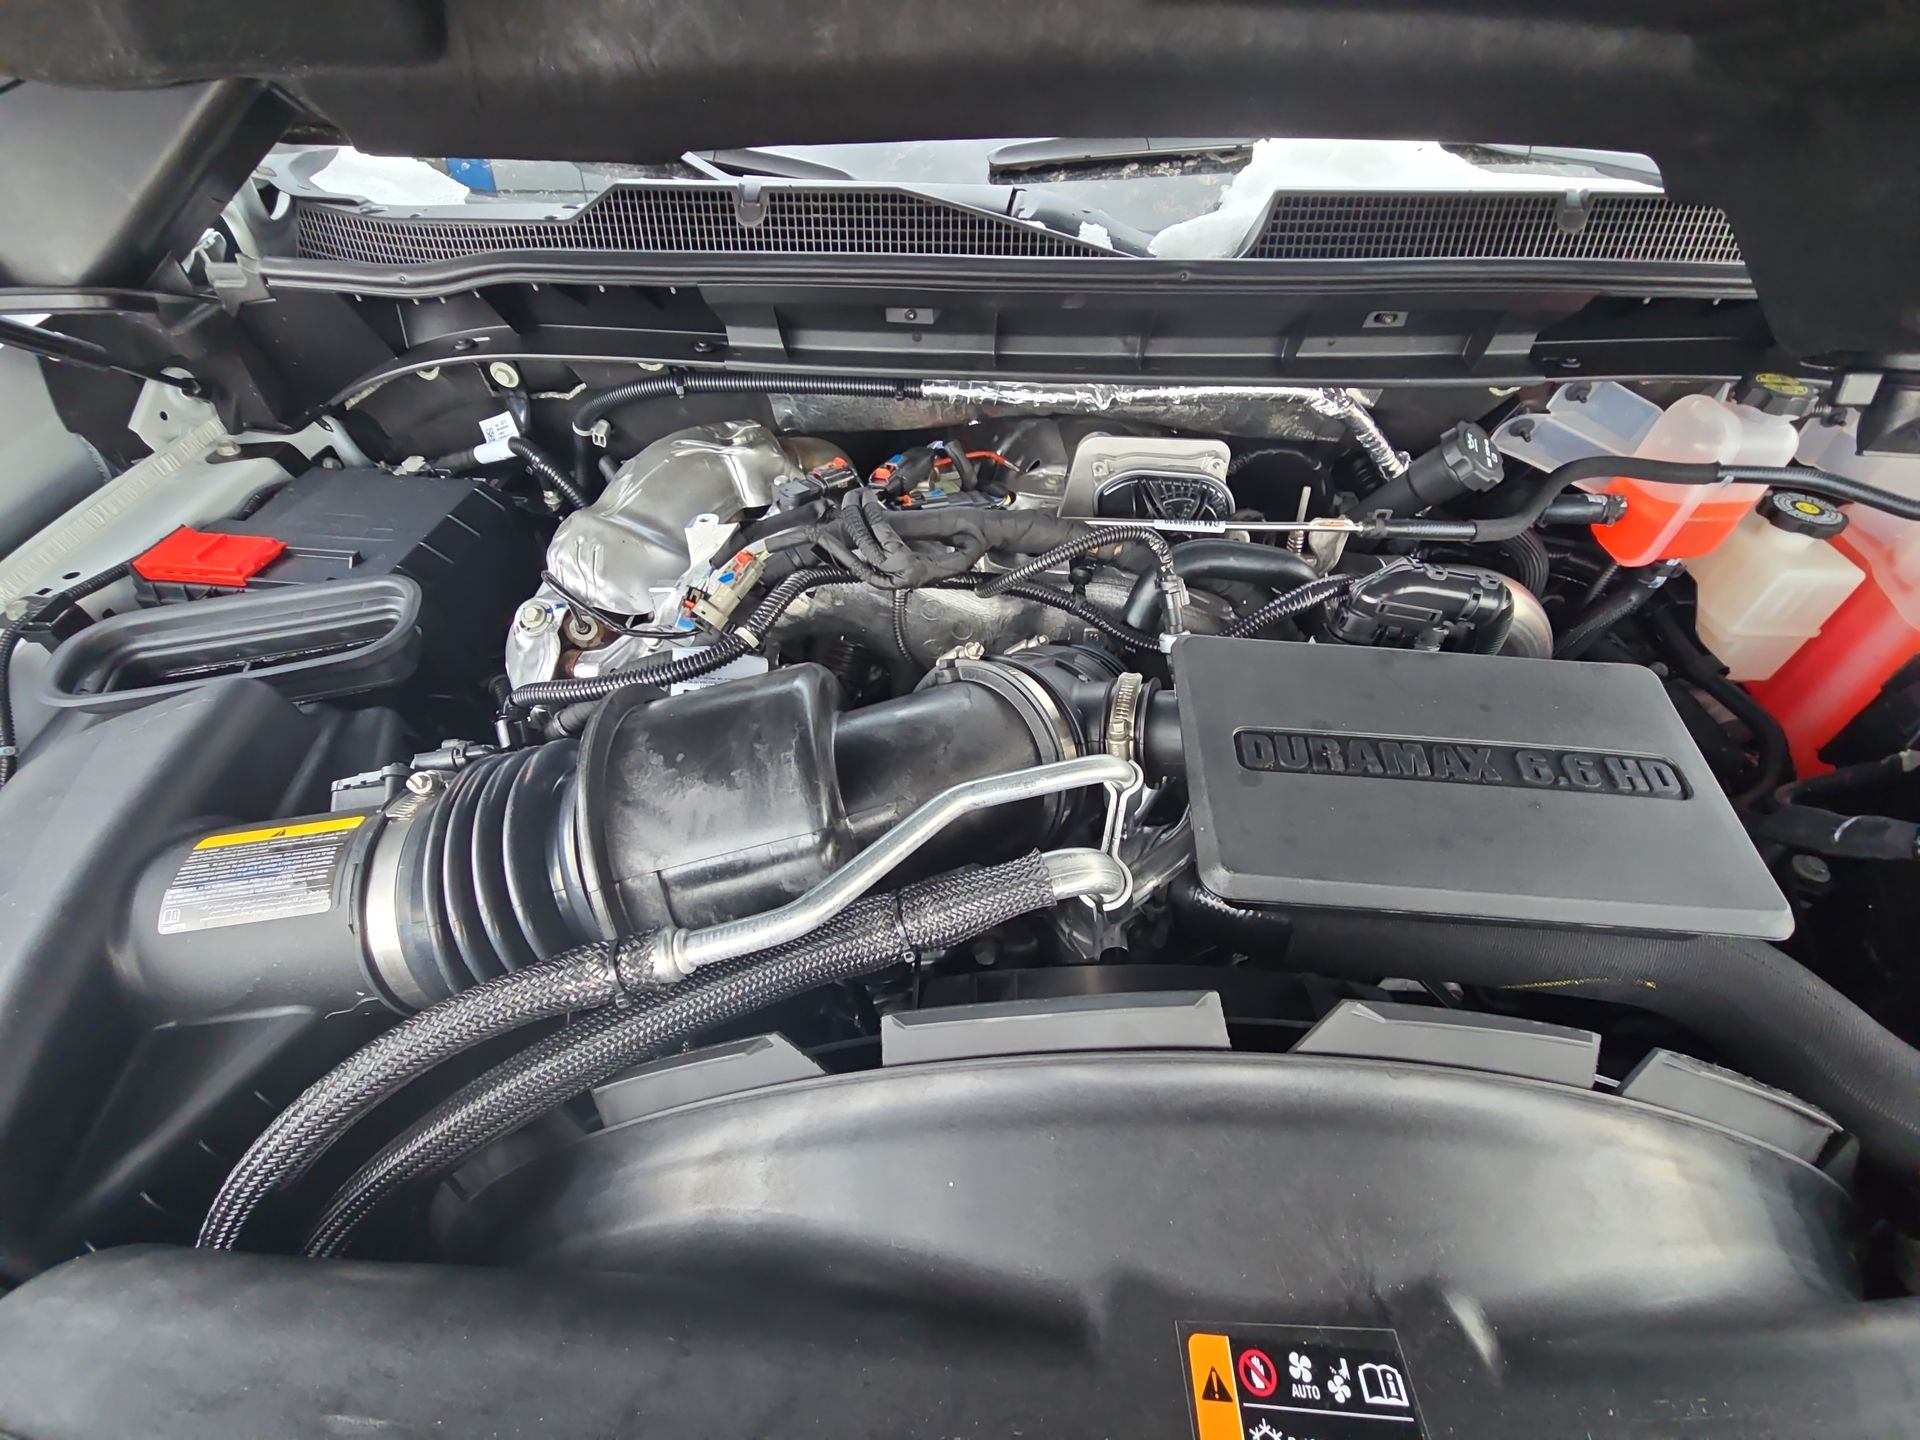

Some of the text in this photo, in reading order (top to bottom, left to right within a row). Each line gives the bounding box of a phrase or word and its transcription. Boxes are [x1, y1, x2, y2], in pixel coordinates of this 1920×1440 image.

[1241, 733, 1683, 795] DURAMAX 6.6 HD
[1291, 1383, 1321, 1400] AUTO
